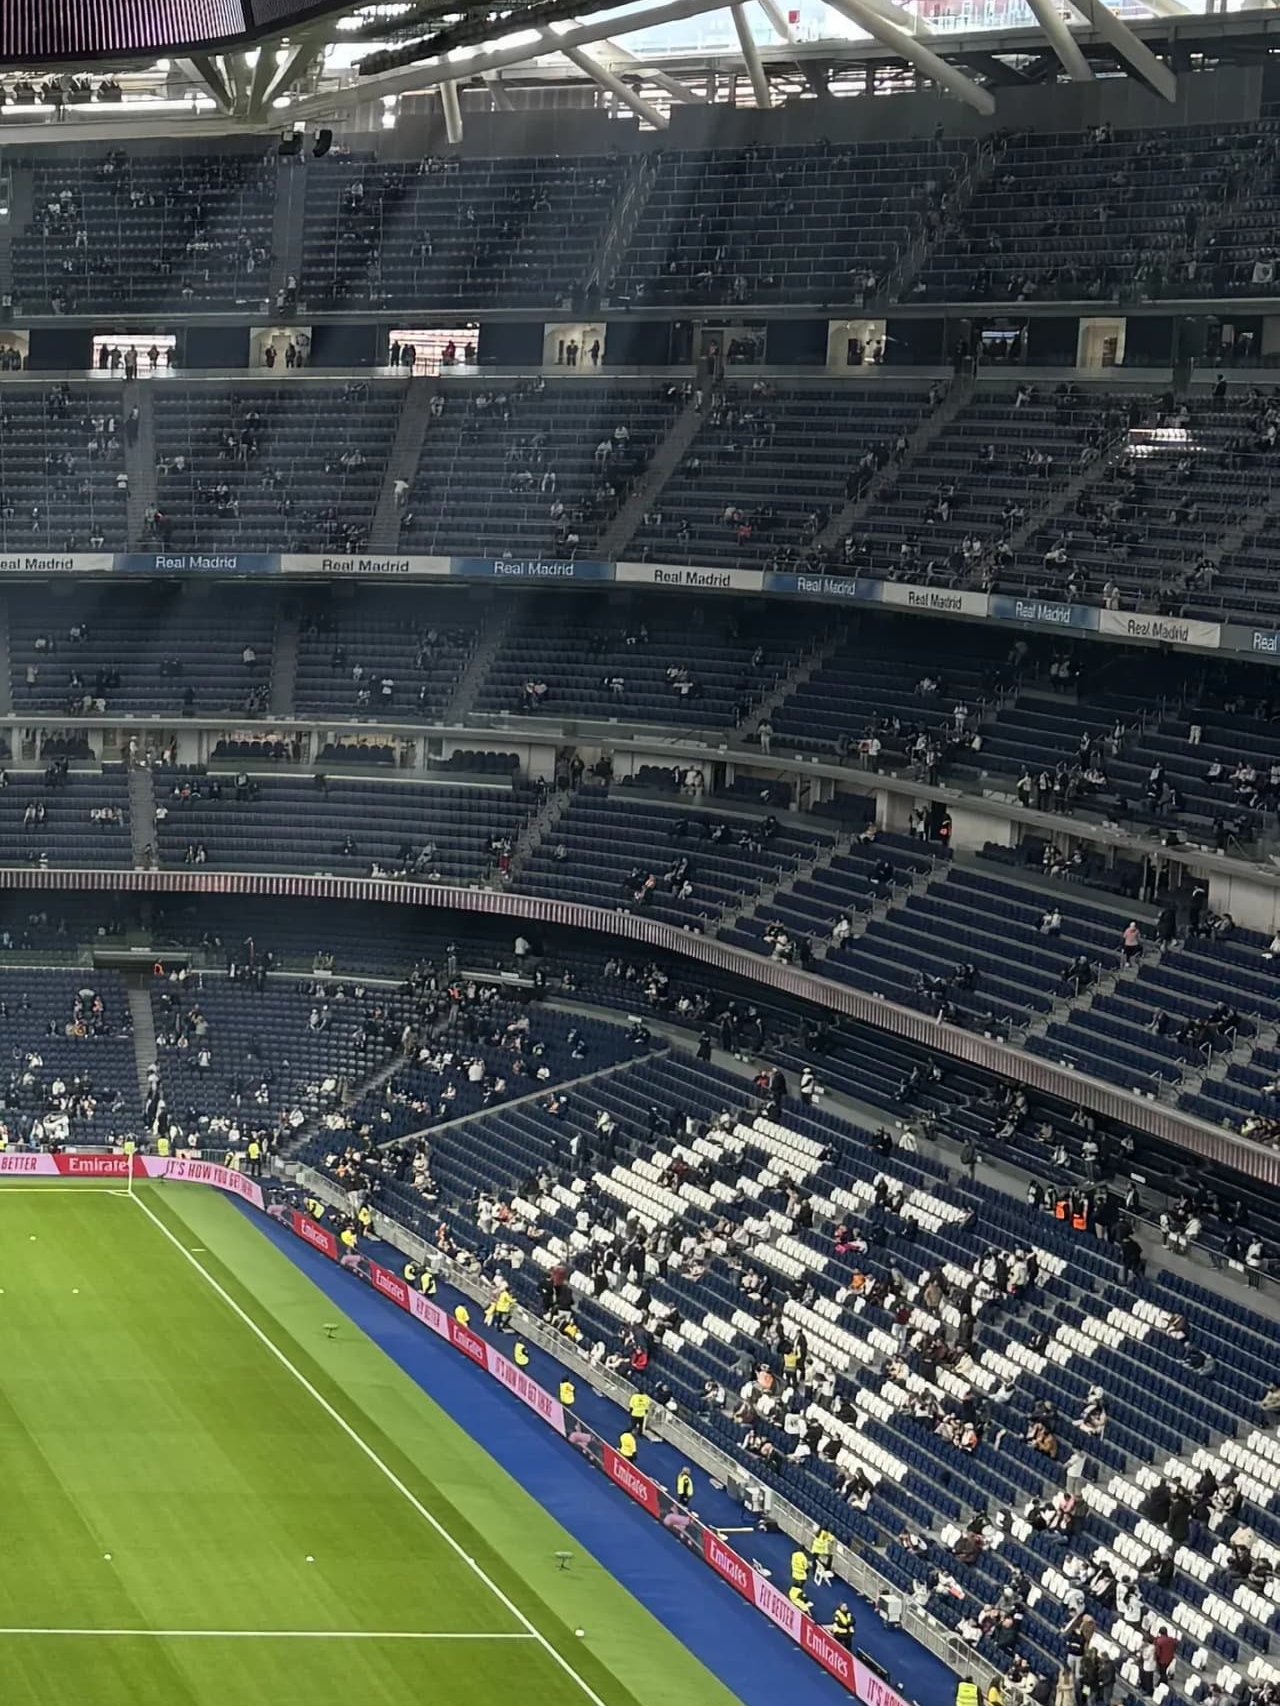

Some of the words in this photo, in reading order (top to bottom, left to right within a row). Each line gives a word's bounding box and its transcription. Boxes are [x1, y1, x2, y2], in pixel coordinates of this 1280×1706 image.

[25, 556, 74, 571] Madrid
[155, 556, 186, 569] Real
[189, 555, 237, 570] Madrid
[323, 558, 357, 572] Real
[360, 559, 409, 573] Madrid
[494, 560, 524, 575] Real
[527, 561, 574, 576] Madrid
[653, 570, 681, 585] Real
[685, 571, 731, 587] Madrid
[908, 591, 930, 608] Real
[931, 593, 962, 611] Madrid
[1, 1156, 37, 1171] BETTER
[300, 1219, 329, 1250] Emirates
[375, 1269, 405, 1302] Emirates
[452, 1324, 484, 1360] Emirates
[613, 1457, 648, 1502] Emirates
[709, 1543, 748, 1589] Emirates
[759, 1583, 771, 1608] FLY
[771, 1592, 795, 1631] BETTER
[806, 1625, 849, 1678] Emirates
